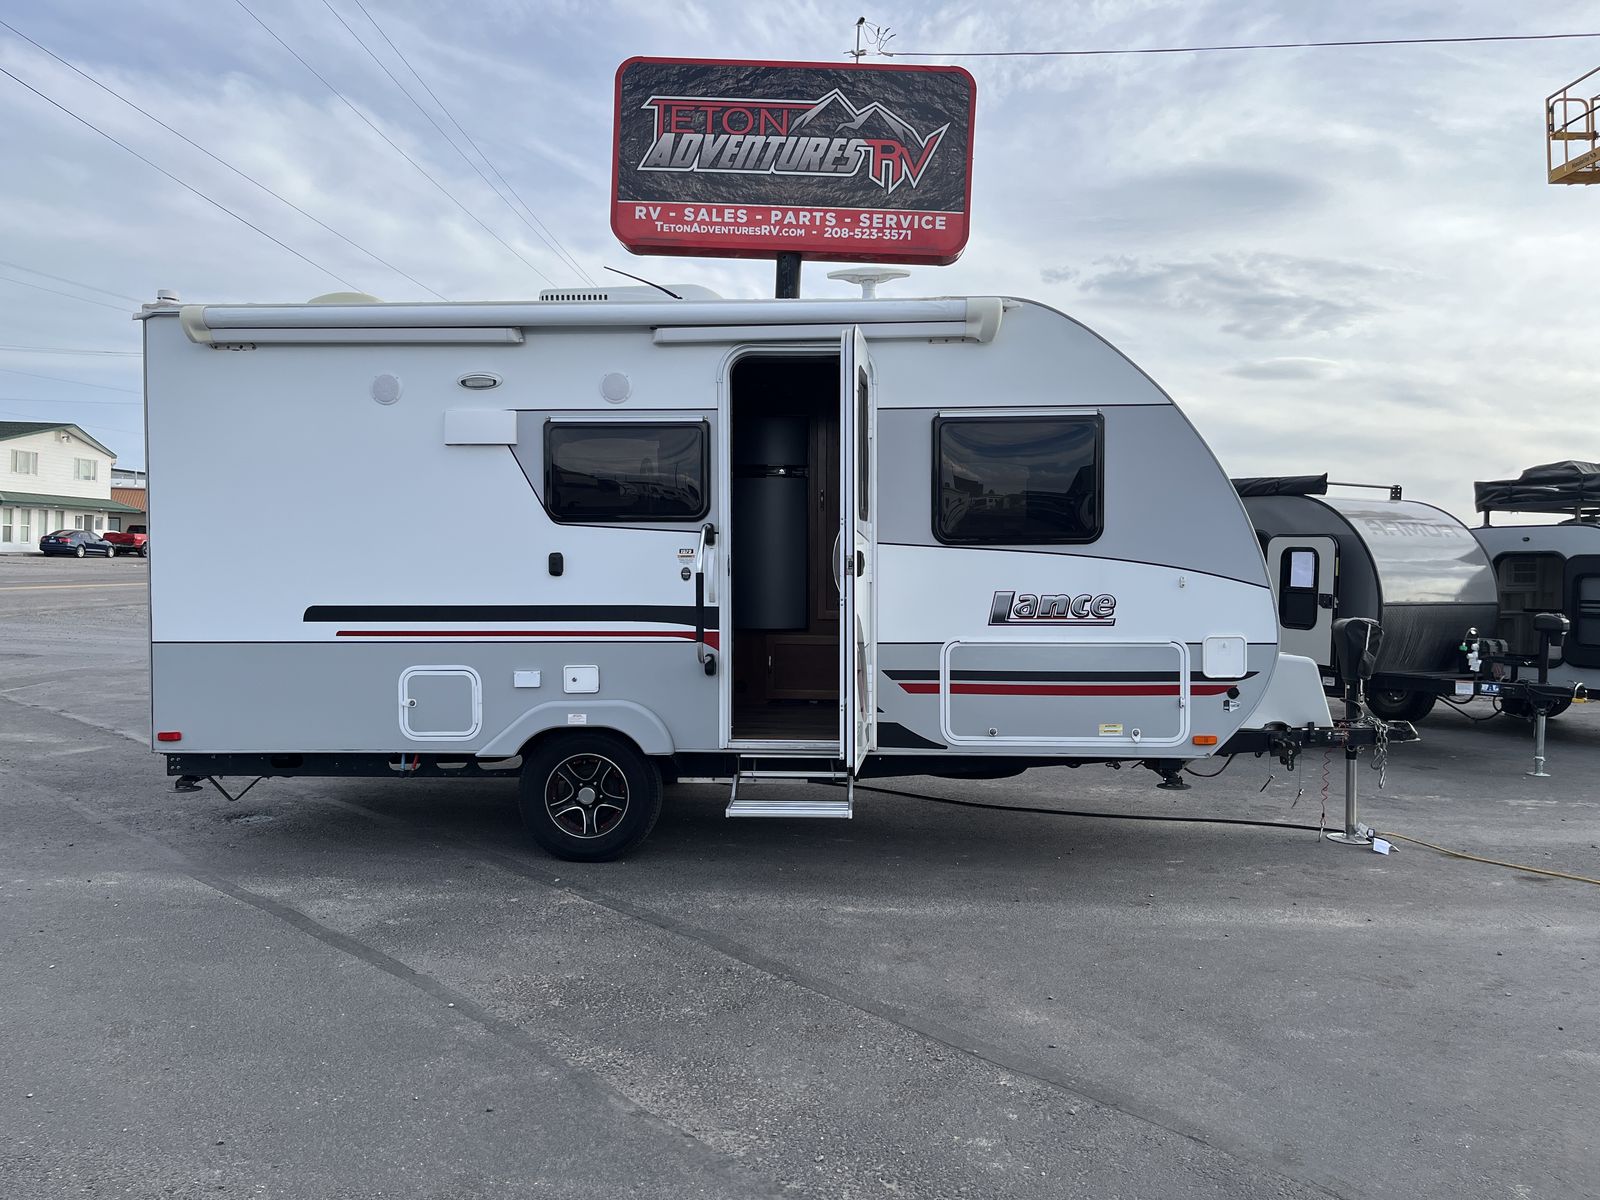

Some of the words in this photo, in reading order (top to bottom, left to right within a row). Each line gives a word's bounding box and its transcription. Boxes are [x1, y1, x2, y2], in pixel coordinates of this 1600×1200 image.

[651, 99, 790, 137] TETON
[642, 132, 867, 172] ADVENTURES
[864, 134, 942, 186] RV
[635, 206, 662, 220] RV
[684, 207, 748, 223] SALES
[770, 210, 837, 226] PARTS
[859, 213, 947, 230] SERVICE
[824, 228, 912, 240] 208-523-3571
[988, 591, 1116, 626] Lance
